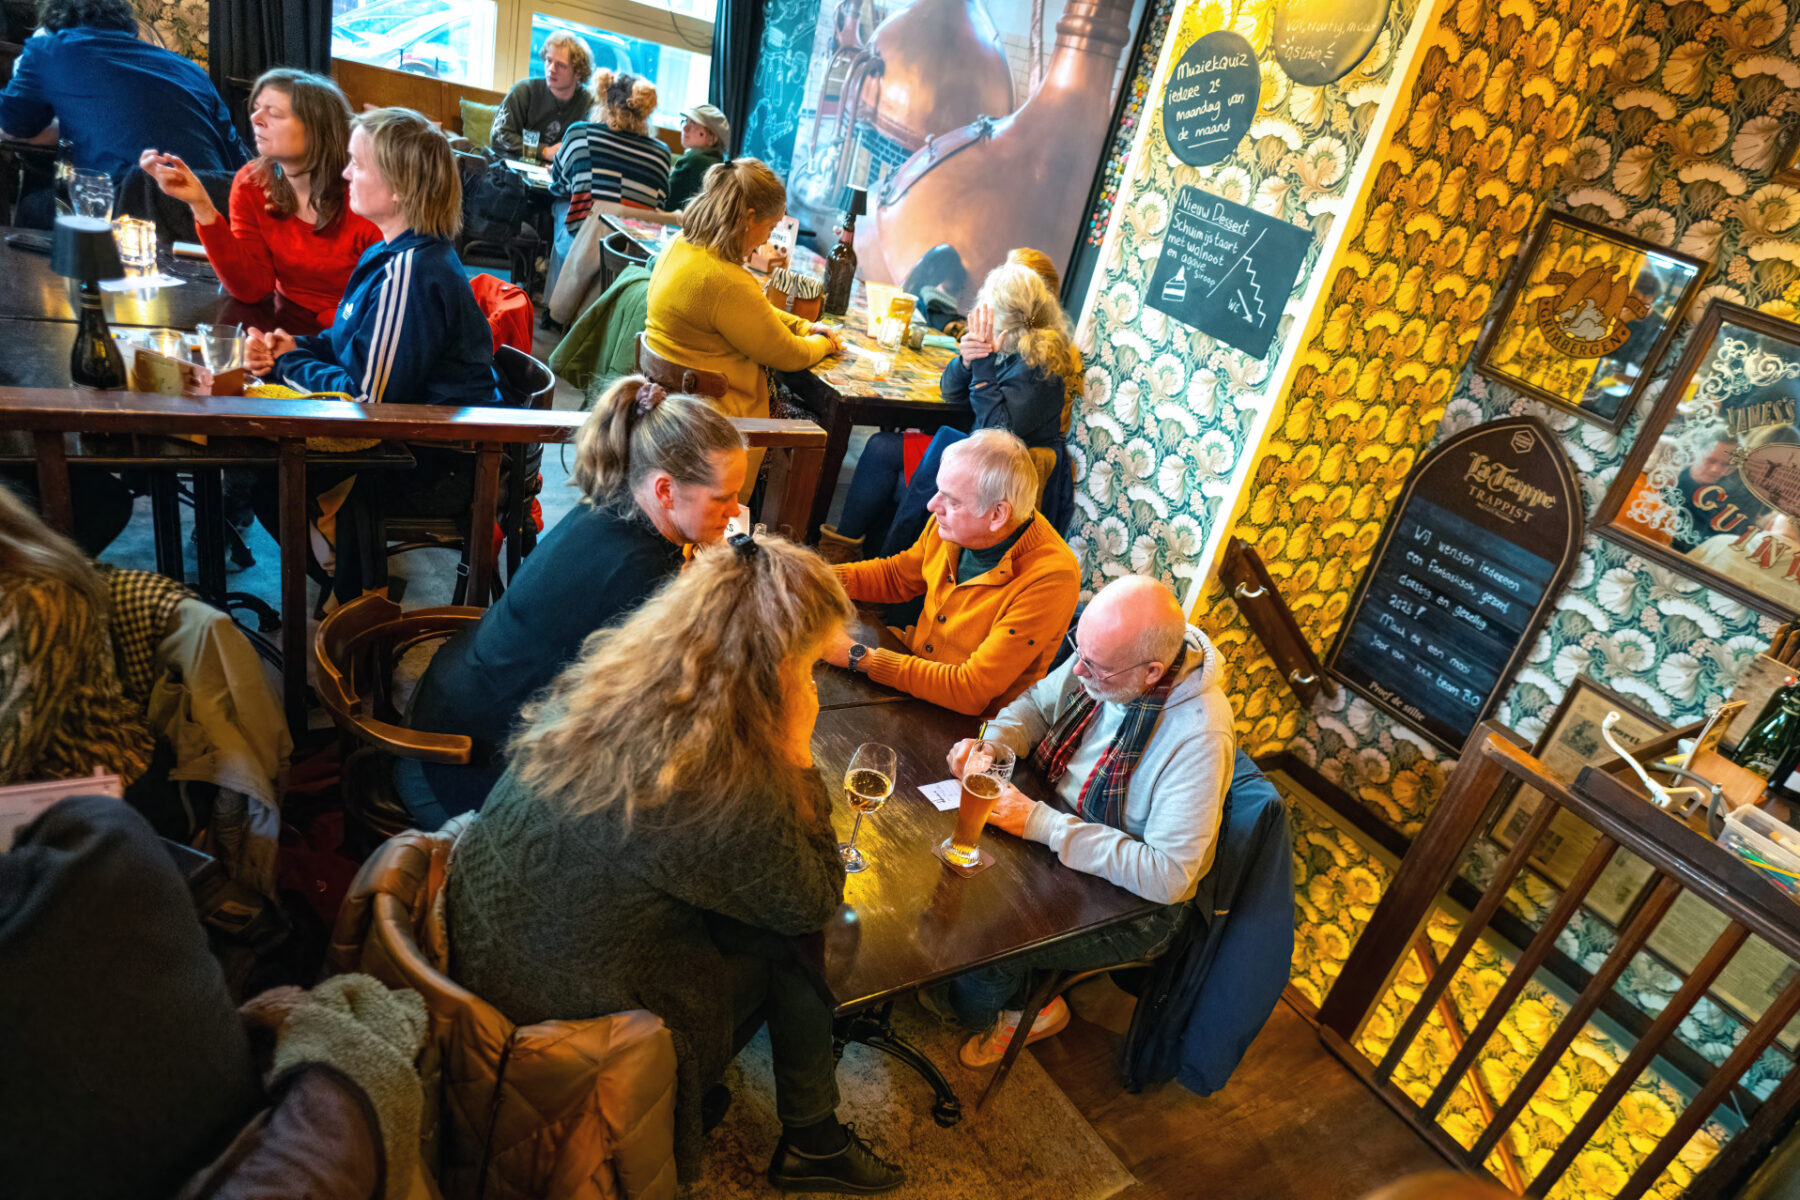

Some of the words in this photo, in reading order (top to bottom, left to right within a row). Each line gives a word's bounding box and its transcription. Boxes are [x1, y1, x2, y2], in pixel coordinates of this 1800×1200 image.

[1176, 99, 1220, 121] maandag
[1227, 93, 1245, 107] van
[1177, 127, 1189, 141] de
[1195, 118, 1230, 137] maand
[1178, 189, 1210, 218] Nieuw
[1212, 203, 1250, 235] Dessert
[1167, 234, 1185, 247] met
[1187, 241, 1224, 266] walnoot
[1167, 248, 1177, 258] en
[1181, 254, 1206, 271] agave
[1540, 307, 1622, 356] GRIMBERGEN
[1487, 463, 1556, 509] Trappe
[1469, 484, 1534, 522] TRAPPIST
[1406, 551, 1423, 566] een
[1438, 541, 1474, 567] wensen
[1436, 596, 1450, 608] en
[1436, 675, 1460, 697] team
[1369, 681, 1394, 701] Proef
[1391, 695, 1403, 706] de
[1402, 703, 1425, 721] stilte
